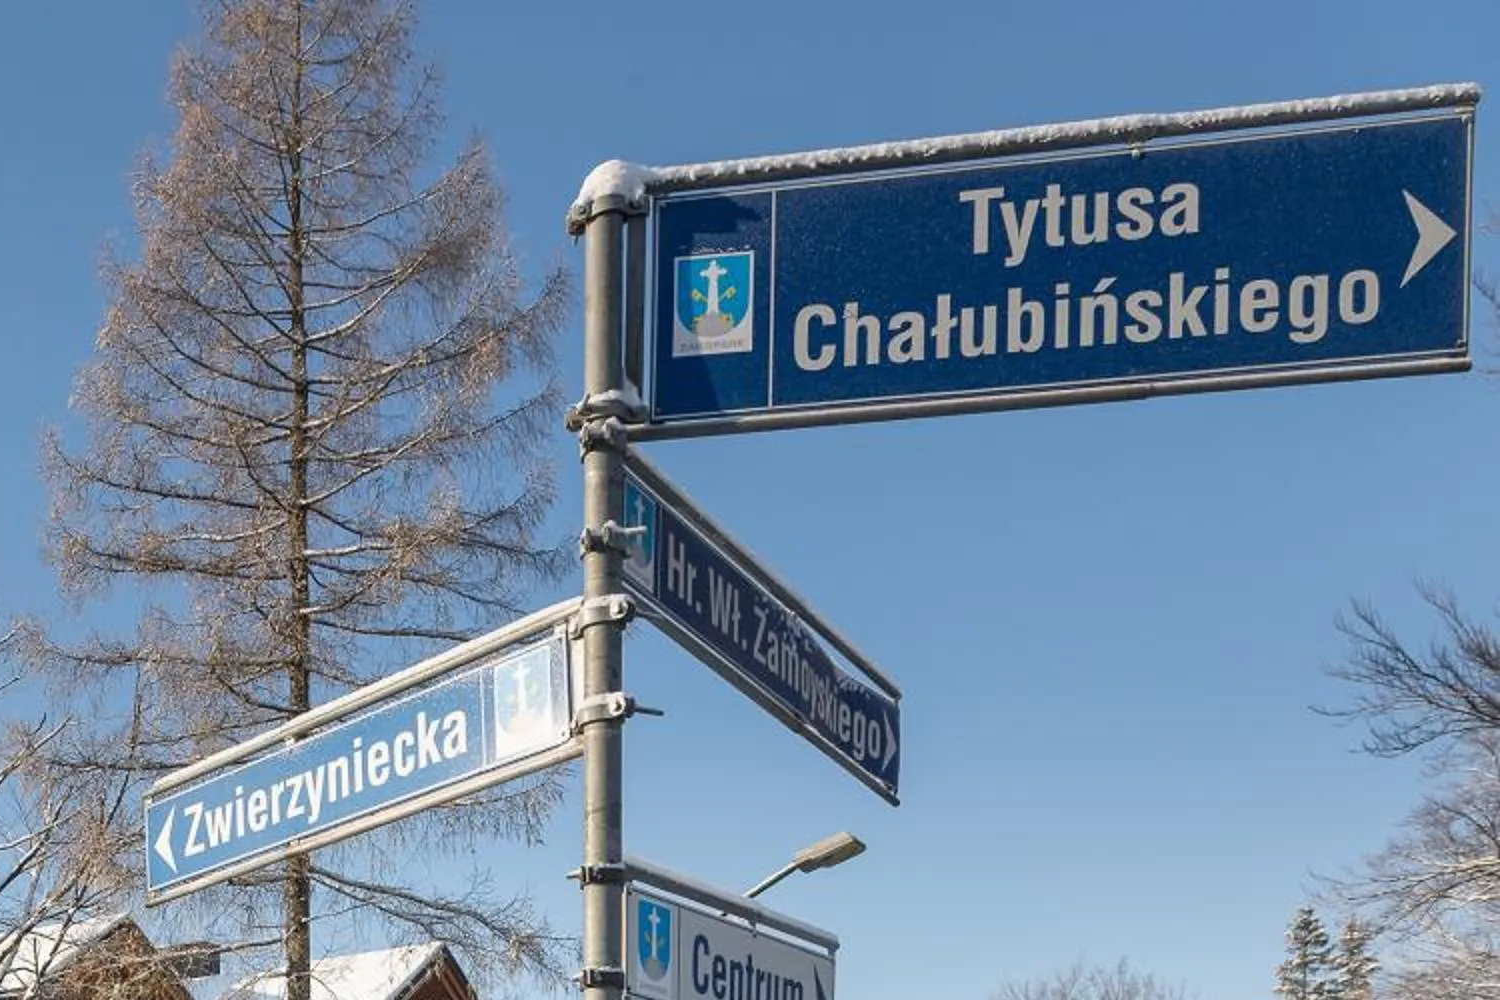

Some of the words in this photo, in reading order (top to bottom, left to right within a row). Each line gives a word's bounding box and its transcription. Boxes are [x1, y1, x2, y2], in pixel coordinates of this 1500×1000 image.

[960, 182, 1201, 268] Tytusa
[793, 267, 1380, 373] Chałubińskiego
[667, 534, 701, 614] Hr.
[709, 566, 748, 650] Wł.
[753, 605, 881, 761] Zamoyskiego
[183, 710, 468, 857] Zwierzyniecka
